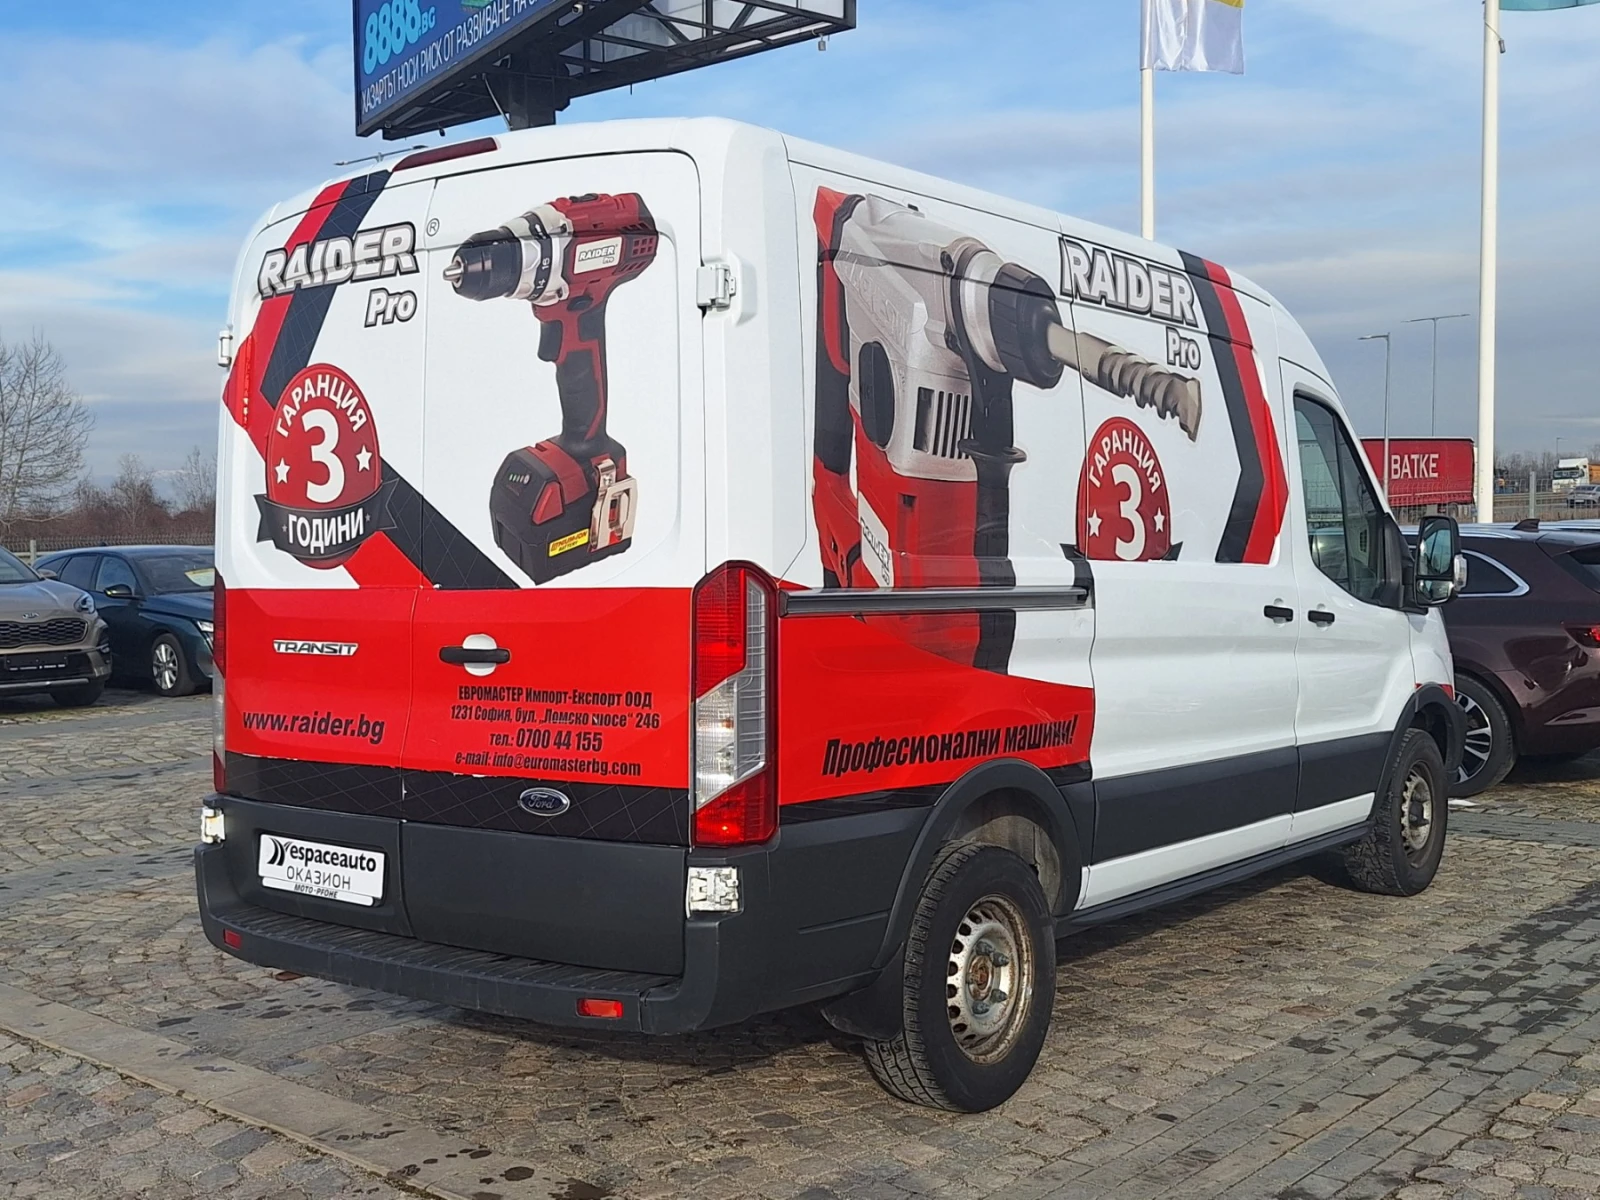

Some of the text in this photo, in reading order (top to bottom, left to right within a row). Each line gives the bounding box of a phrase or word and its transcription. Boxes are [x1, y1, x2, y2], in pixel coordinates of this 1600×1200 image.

[362, 70, 396, 114] ХАЗАРТЪТ
[398, 54, 419, 91] НОСИ
[420, 39, 443, 76] РИСК
[443, 30, 455, 61] ОТ
[456, 0, 510, 54] РАЗВИВАНЕ
[258, 221, 419, 300] RAIDER
[578, 245, 615, 262] RAIDER
[1058, 233, 1199, 328] RAIDER
[364, 288, 417, 327] Pro
[1165, 327, 1201, 370] Pro
[276, 374, 367, 438] ГАРАНЦИЯ
[302, 409, 345, 503] 3
[1088, 428, 1161, 493] ГАРАНЦИЯ
[1391, 453, 1439, 480] BATKE
[1111, 463, 1146, 561] 3
[288, 507, 365, 554] ГОДИНИ
[273, 640, 359, 656] TRANSIT
[458, 685, 652, 709] ЕВРОМАСТЕР Импорт-Експорт ООД
[242, 711, 385, 745] www.raider.bg
[451, 705, 473, 720] 1231
[474, 705, 513, 723] София,
[515, 707, 537, 723] бул.
[635, 712, 660, 729] 246
[516, 728, 551, 749] 0700
[553, 730, 572, 750] 44
[575, 731, 603, 752] 155
[822, 713, 1079, 777] Професионални машини!
[455, 751, 641, 777] e-mail: info@euromasterbg.com
[528, 794, 555, 810] Ford
[290, 845, 377, 872] espaceauto
[287, 866, 351, 890] ОКАЗИОН
